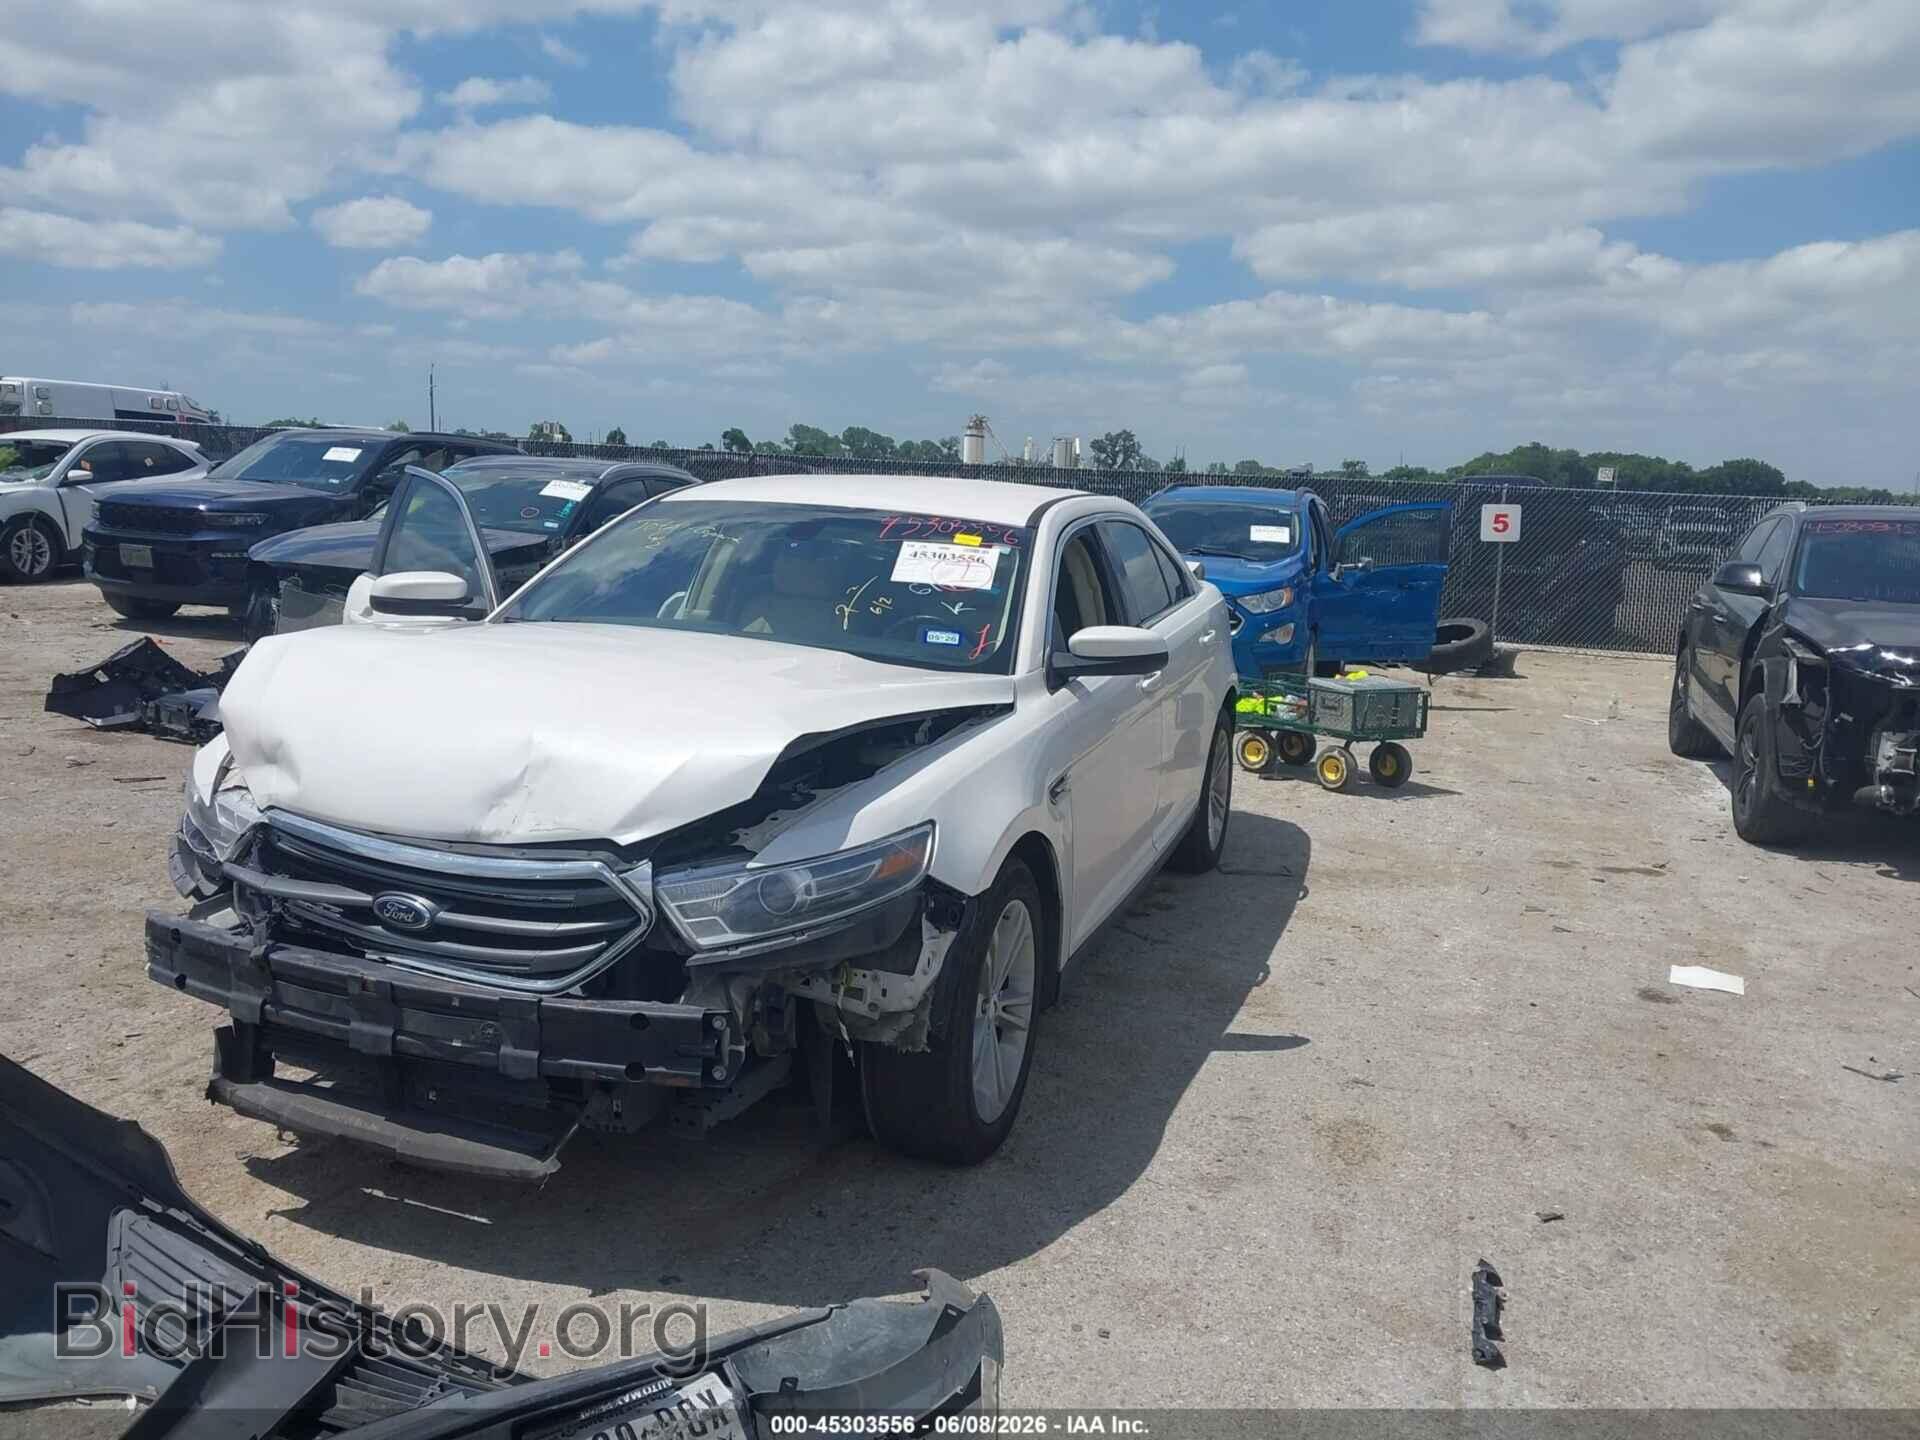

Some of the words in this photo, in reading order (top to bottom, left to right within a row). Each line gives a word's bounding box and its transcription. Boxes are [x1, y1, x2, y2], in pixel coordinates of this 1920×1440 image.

[1492, 513, 1509, 533] 5
[908, 549, 985, 564] 45303556
[383, 901, 416, 922] Ford
